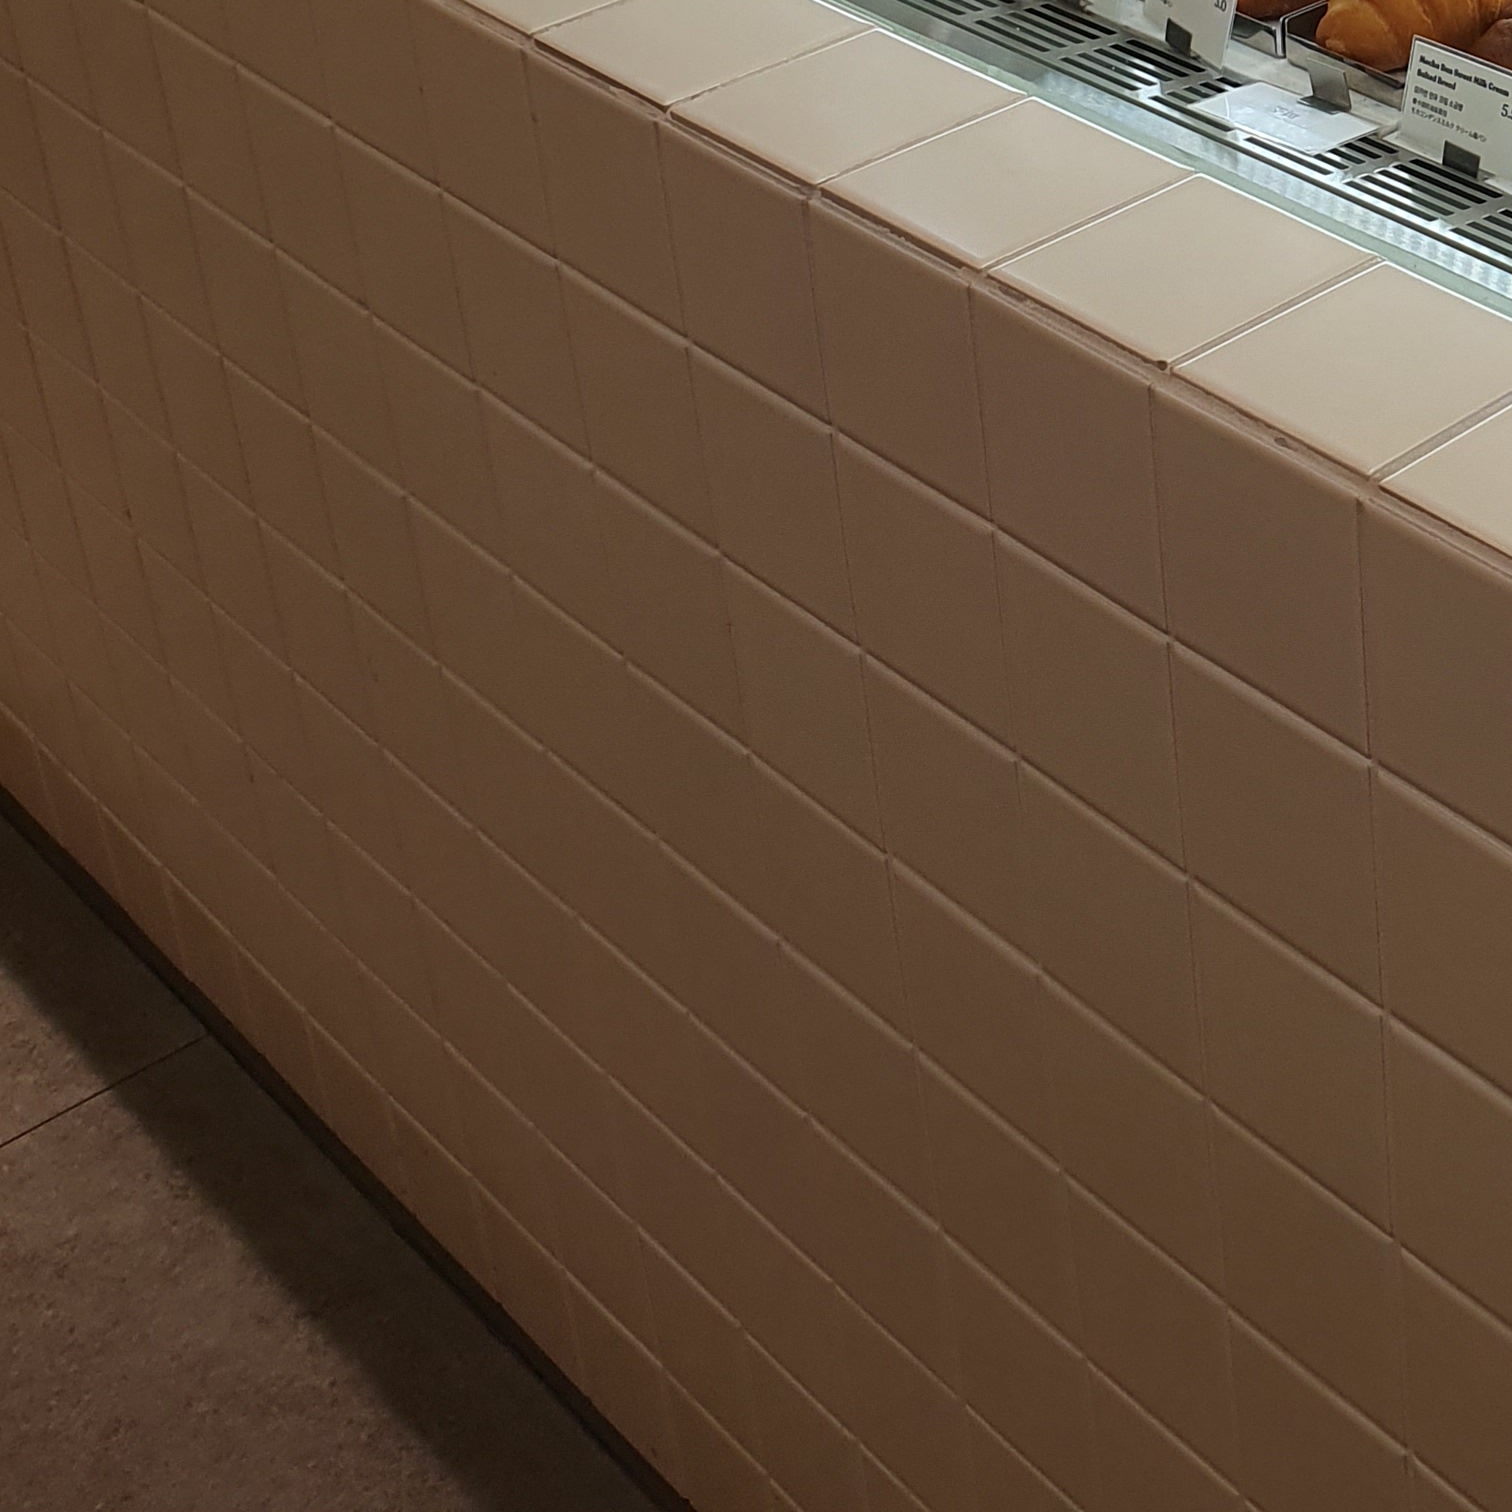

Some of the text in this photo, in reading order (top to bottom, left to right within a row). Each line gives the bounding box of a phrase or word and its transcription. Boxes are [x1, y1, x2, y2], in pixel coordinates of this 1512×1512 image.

[1417, 68, 1456, 90] Salted Bread
[1419, 55, 1440, 69] Mocha
[1454, 69, 1472, 82] Sweet
[1473, 76, 1487, 88] Milk
[1488, 82, 1509, 97] Cream
